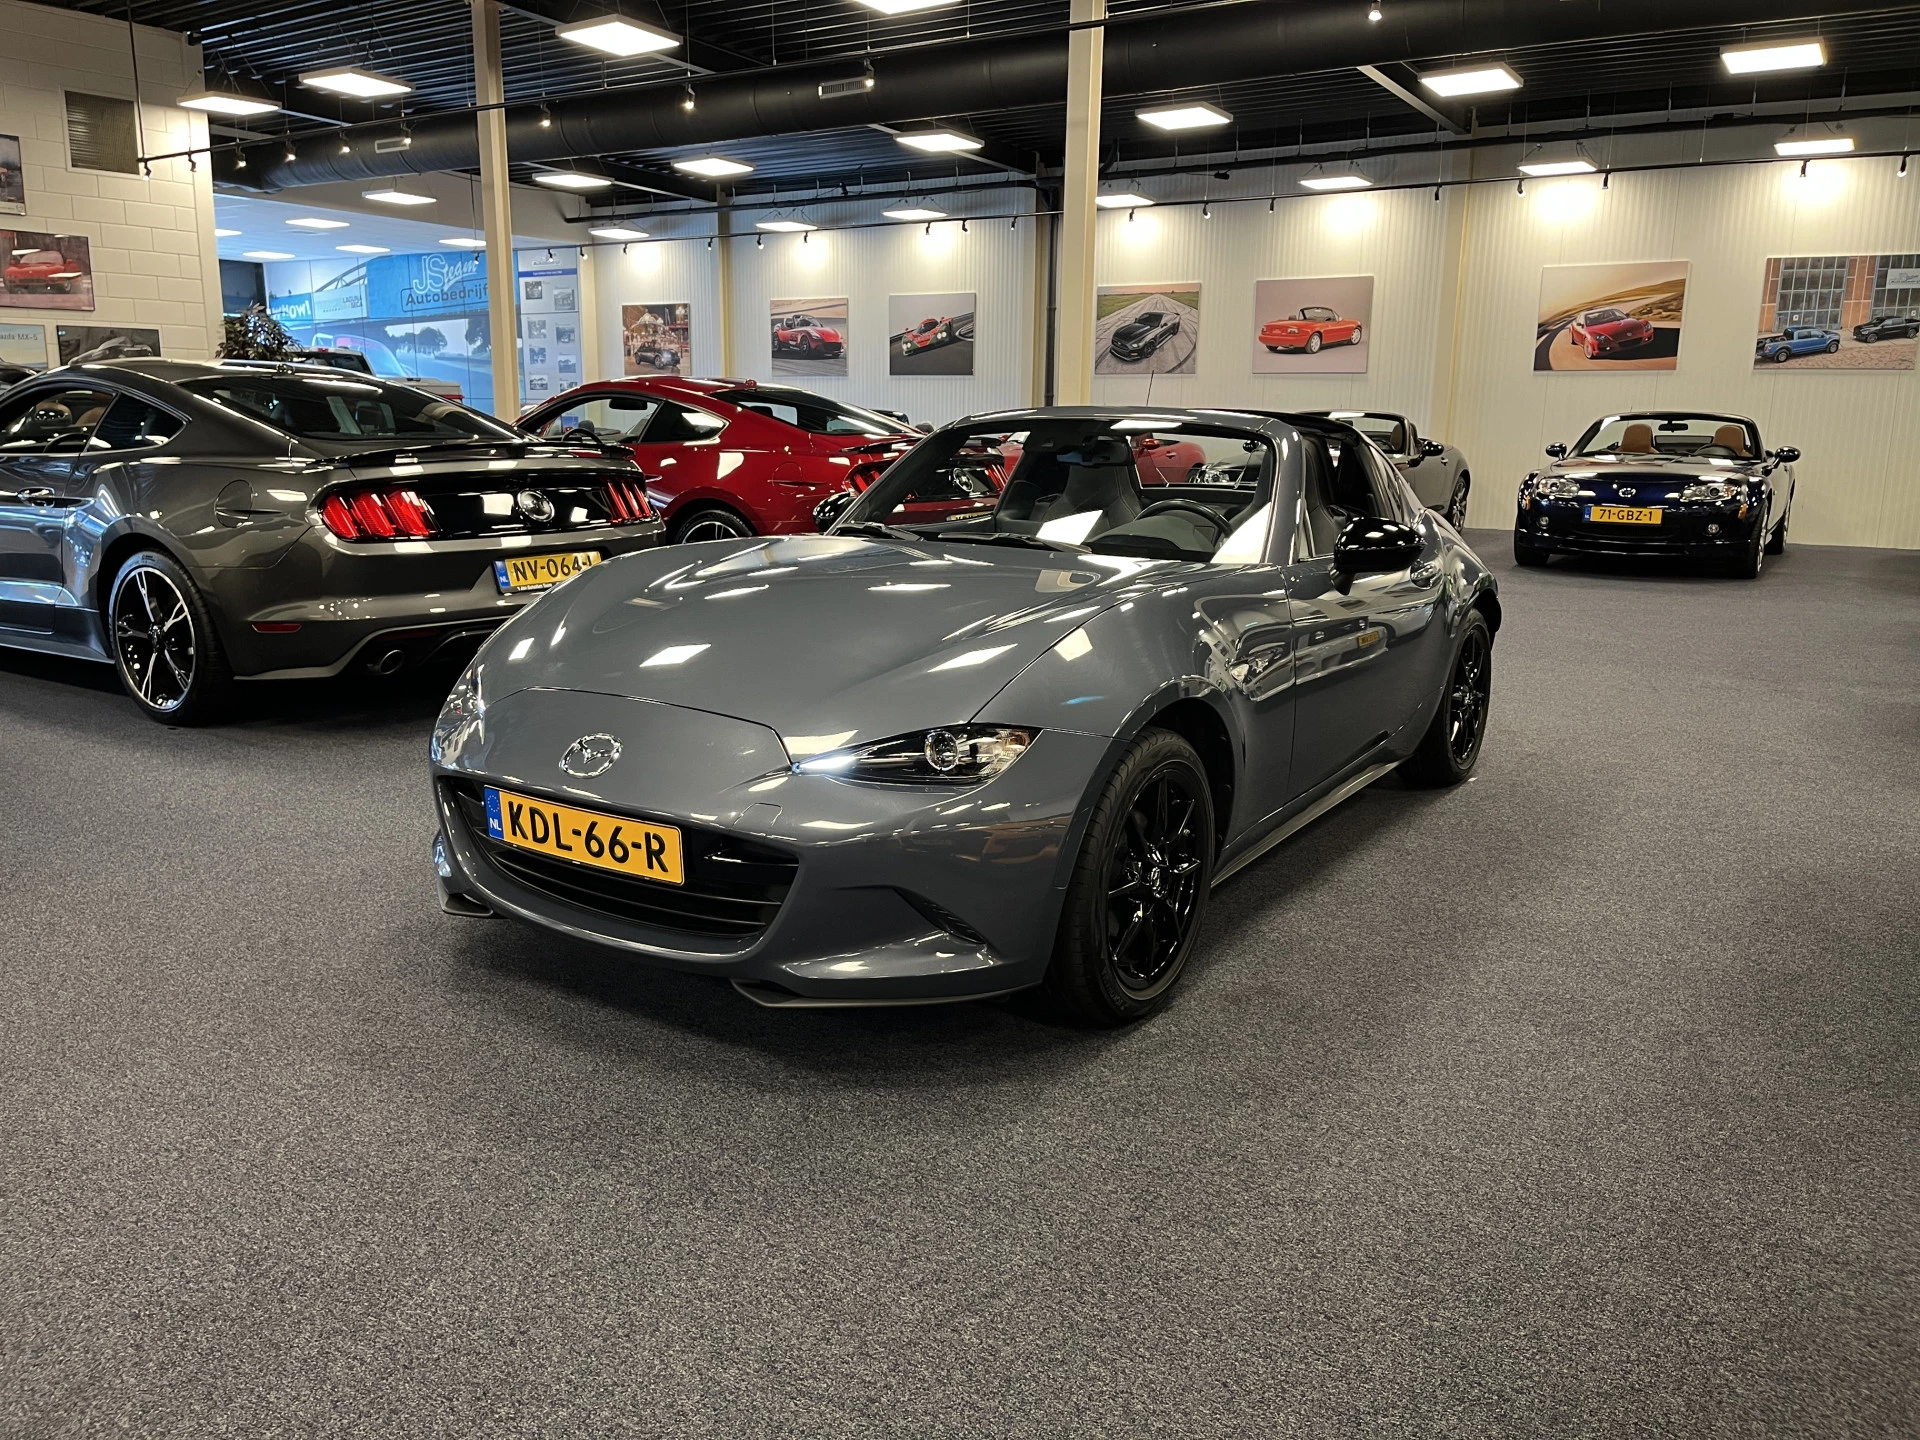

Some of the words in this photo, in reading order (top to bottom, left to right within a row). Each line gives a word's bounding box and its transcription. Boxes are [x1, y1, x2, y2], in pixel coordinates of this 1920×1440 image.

[406, 284, 488, 306] Autobedrijf
[0, 332, 15, 340] azda
[17, 333, 38, 341] MX-5
[1599, 509, 1653, 522] 71-GBZ-1
[500, 575, 509, 583] NL
[490, 817, 502, 831] NL
[508, 801, 669, 873] KDL-66-R
